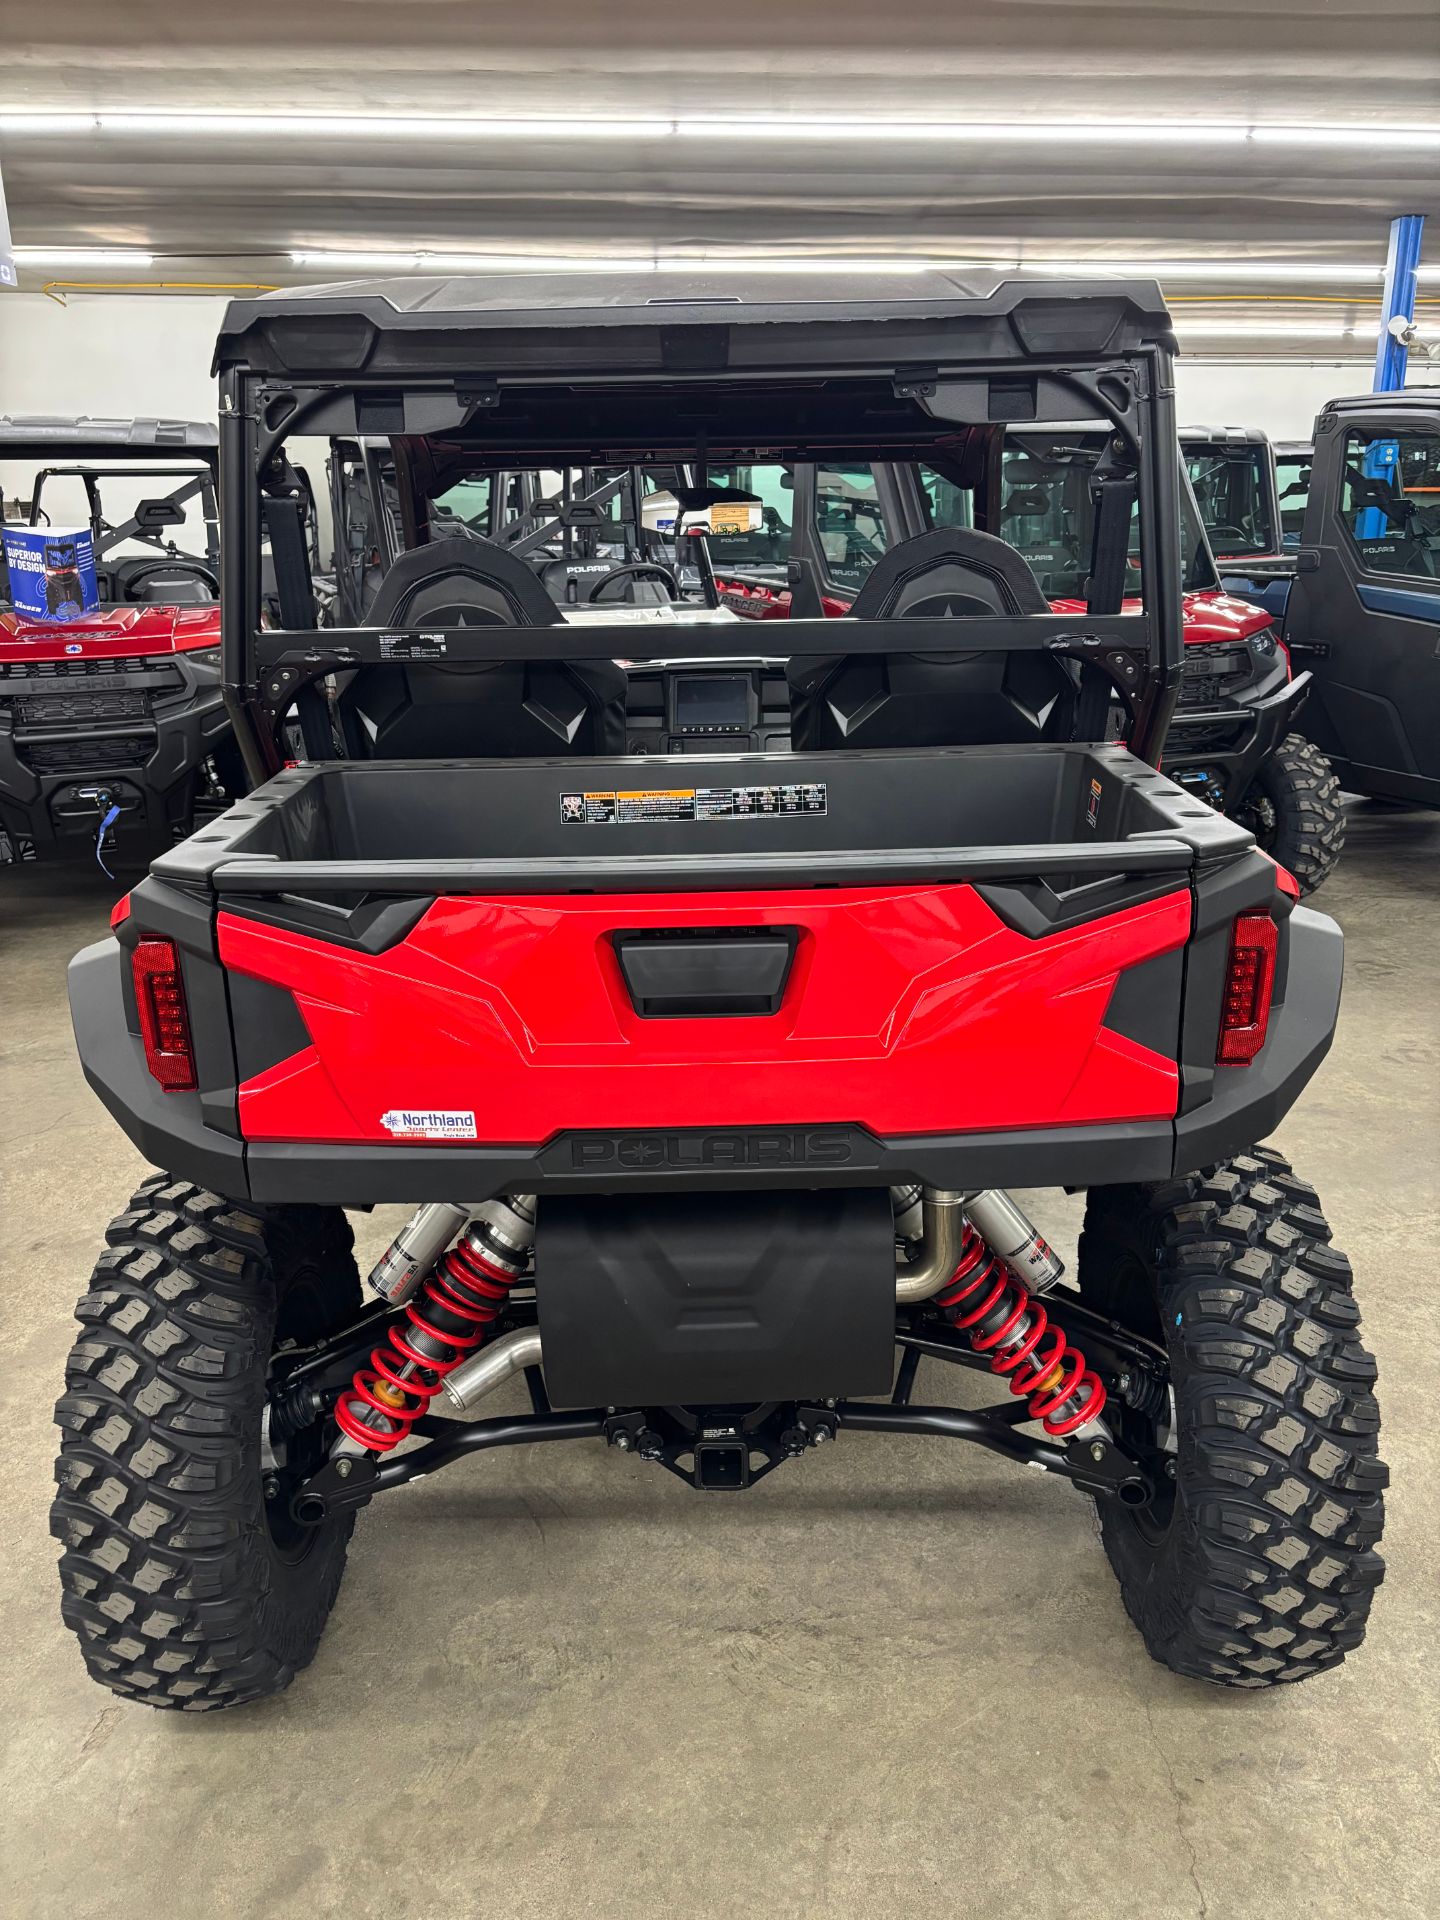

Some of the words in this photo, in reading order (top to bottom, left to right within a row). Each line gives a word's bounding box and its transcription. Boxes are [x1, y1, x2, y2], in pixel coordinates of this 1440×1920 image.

[7, 547, 43, 563] SUPERIOR
[1362, 546, 1395, 555] POLARIS
[9, 558, 17, 569] BY
[17, 560, 46, 574] DESIGN
[566, 564, 611, 574] POLARIS
[720, 595, 763, 612] RANGER
[30, 676, 127, 691] POLARIS
[402, 1113, 473, 1127] Northland
[571, 1132, 853, 1169] POLARIS
